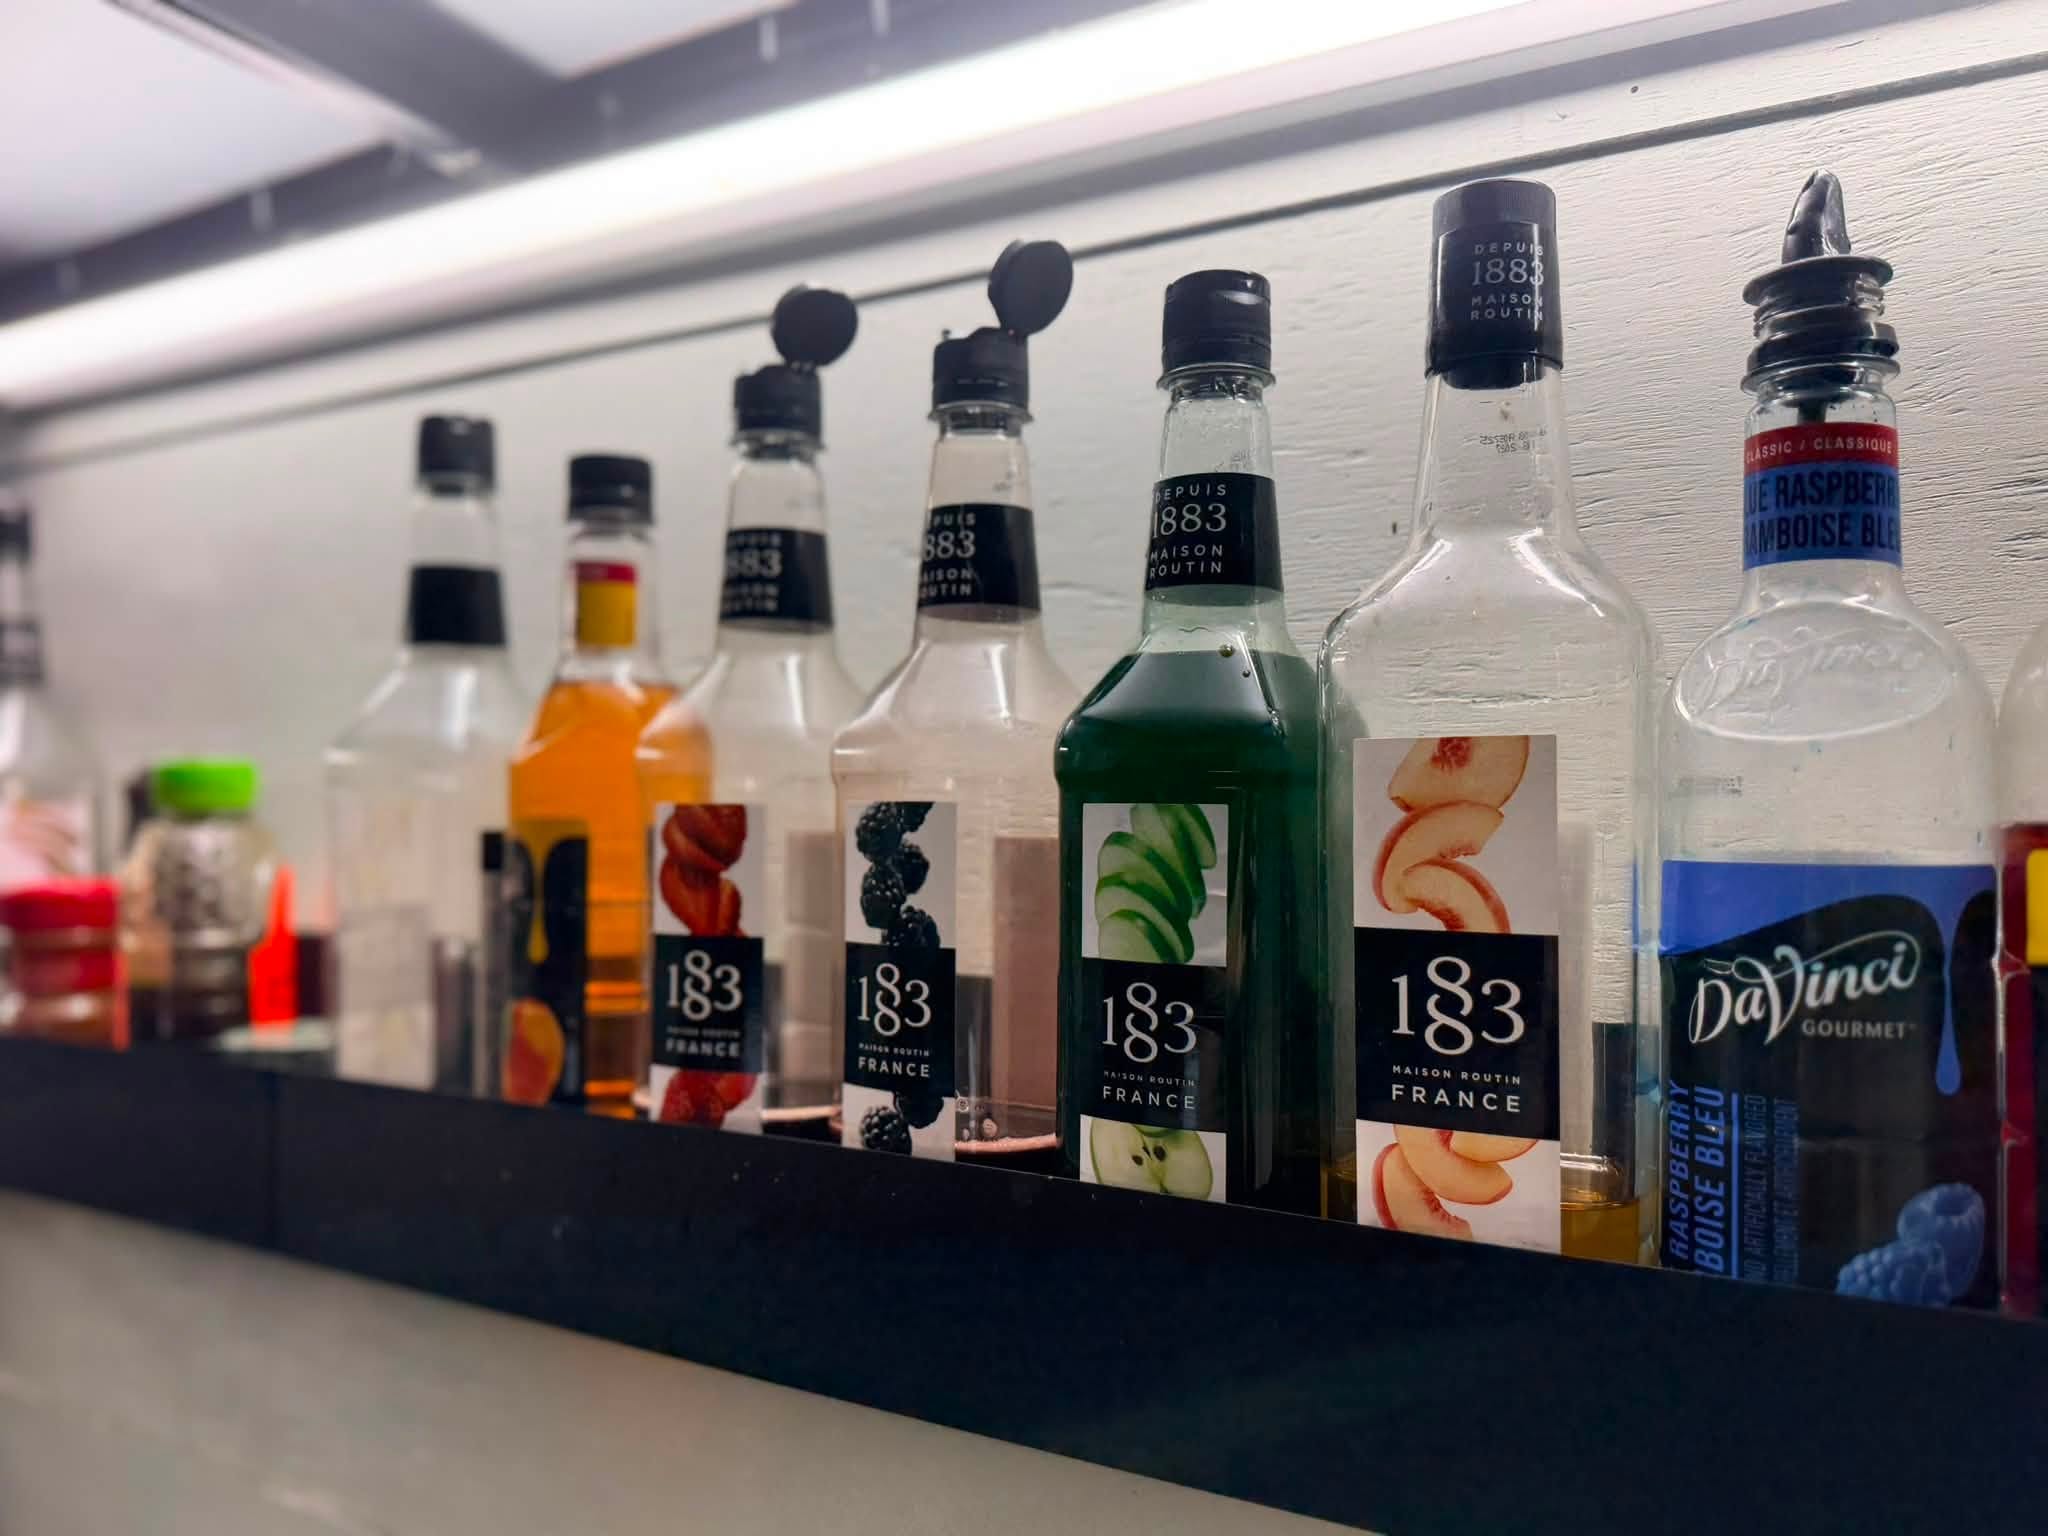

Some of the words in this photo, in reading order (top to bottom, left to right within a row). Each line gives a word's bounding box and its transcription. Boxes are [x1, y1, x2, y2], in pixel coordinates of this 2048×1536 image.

[1474, 242, 1544, 256] DEPUIS
[1472, 258, 1544, 286] 1883
[1471, 293, 1543, 307] MAISON
[1470, 307, 1543, 321] ROUTIN
[1746, 441, 1793, 464] CLASSIC
[1813, 437, 1893, 454] CLASSIQUE
[1155, 483, 1227, 504] DEPUIS
[1153, 503, 1227, 539] 1883
[1861, 513, 1900, 552] BLE
[1150, 544, 1224, 562] MAISON
[1149, 561, 1222, 579] ROUTIN
[1688, 930, 1921, 1045] DaVinci
[1391, 955, 1526, 1056] 1883
[1101, 981, 1198, 1064] 1883
[1802, 1018, 1907, 1040] GOURMET
[665, 1036, 741, 1058] FRANCE
[858, 1056, 931, 1079] FRANCE
[1104, 1070, 1144, 1081] MAISON
[1149, 1075, 1196, 1088] ROUTIN
[1392, 1064, 1451, 1079] MAISON
[1461, 1071, 1521, 1086] ROUTIN
[1103, 1085, 1196, 1110] FRANCE
[1391, 1083, 1521, 1113] FRANCE
[1693, 1086, 1725, 1168] BLEU
[1668, 1080, 1690, 1261] RASPBERRY
[1693, 1175, 1725, 1273] BOISE
